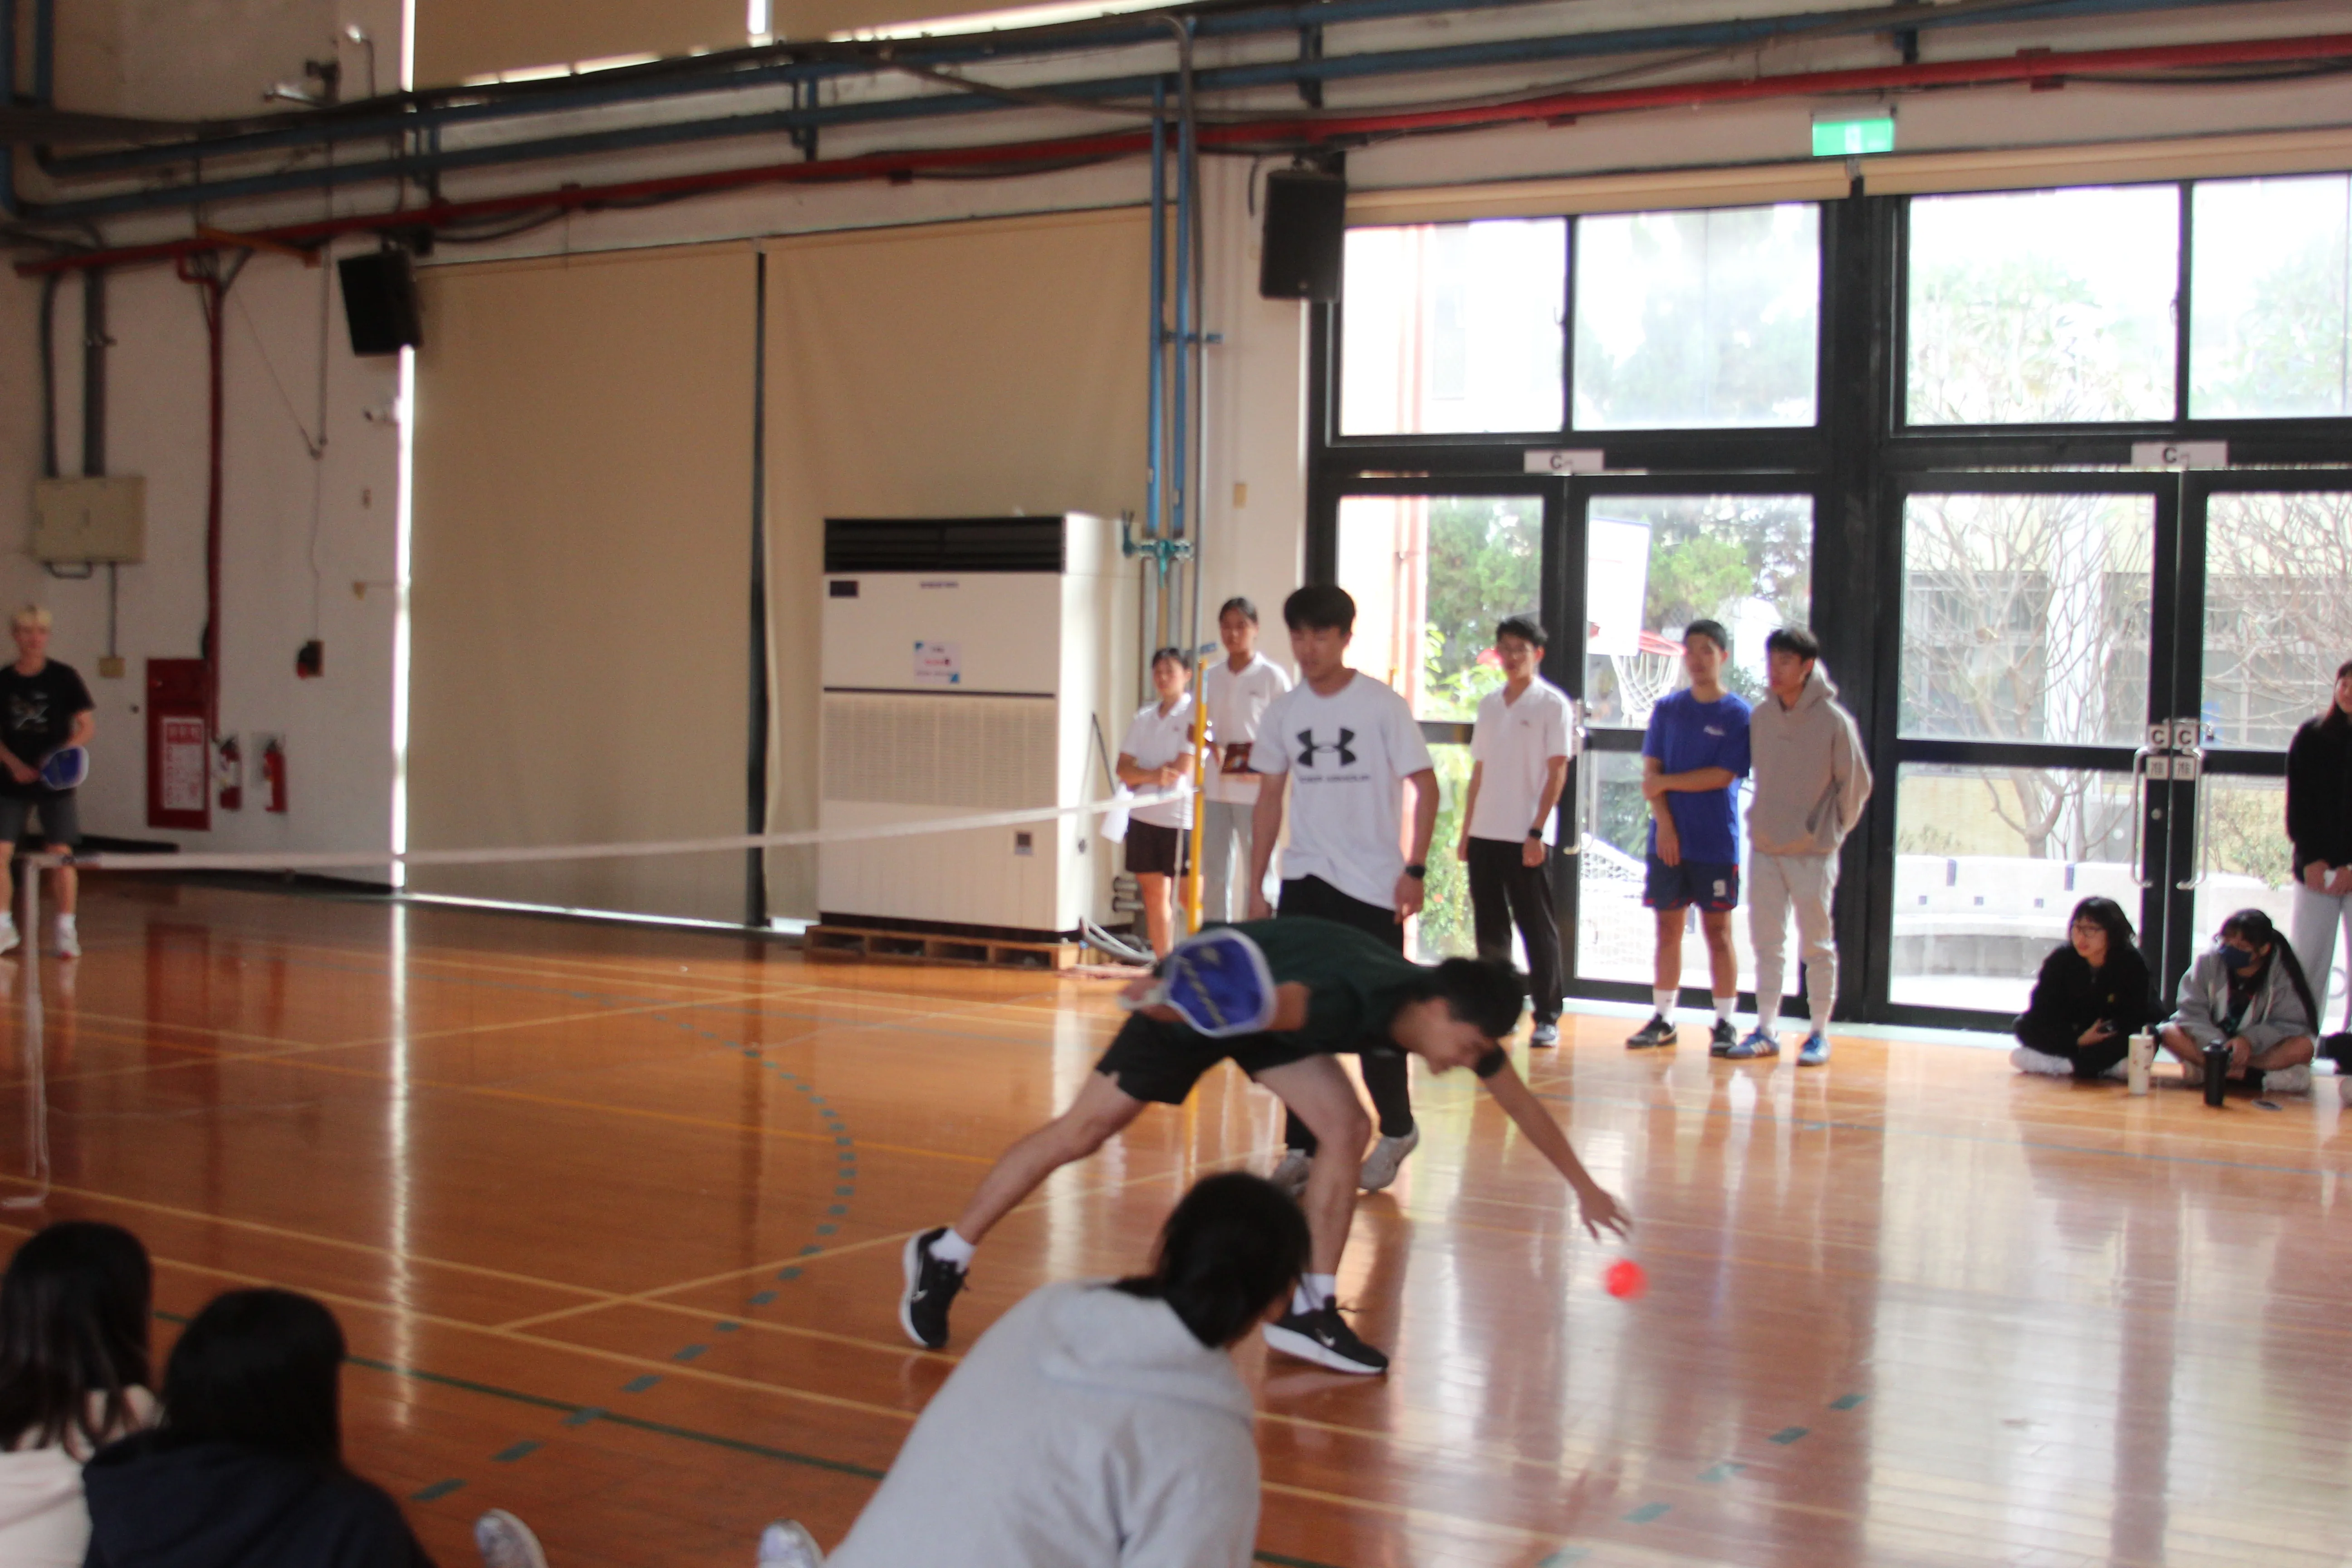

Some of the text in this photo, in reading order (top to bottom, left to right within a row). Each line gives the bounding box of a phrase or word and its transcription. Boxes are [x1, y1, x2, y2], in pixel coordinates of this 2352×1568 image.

[1549, 454, 1562, 469] C
[2163, 447, 2177, 463] C
[2151, 729, 2164, 745] C
[2178, 730, 2191, 745] C
